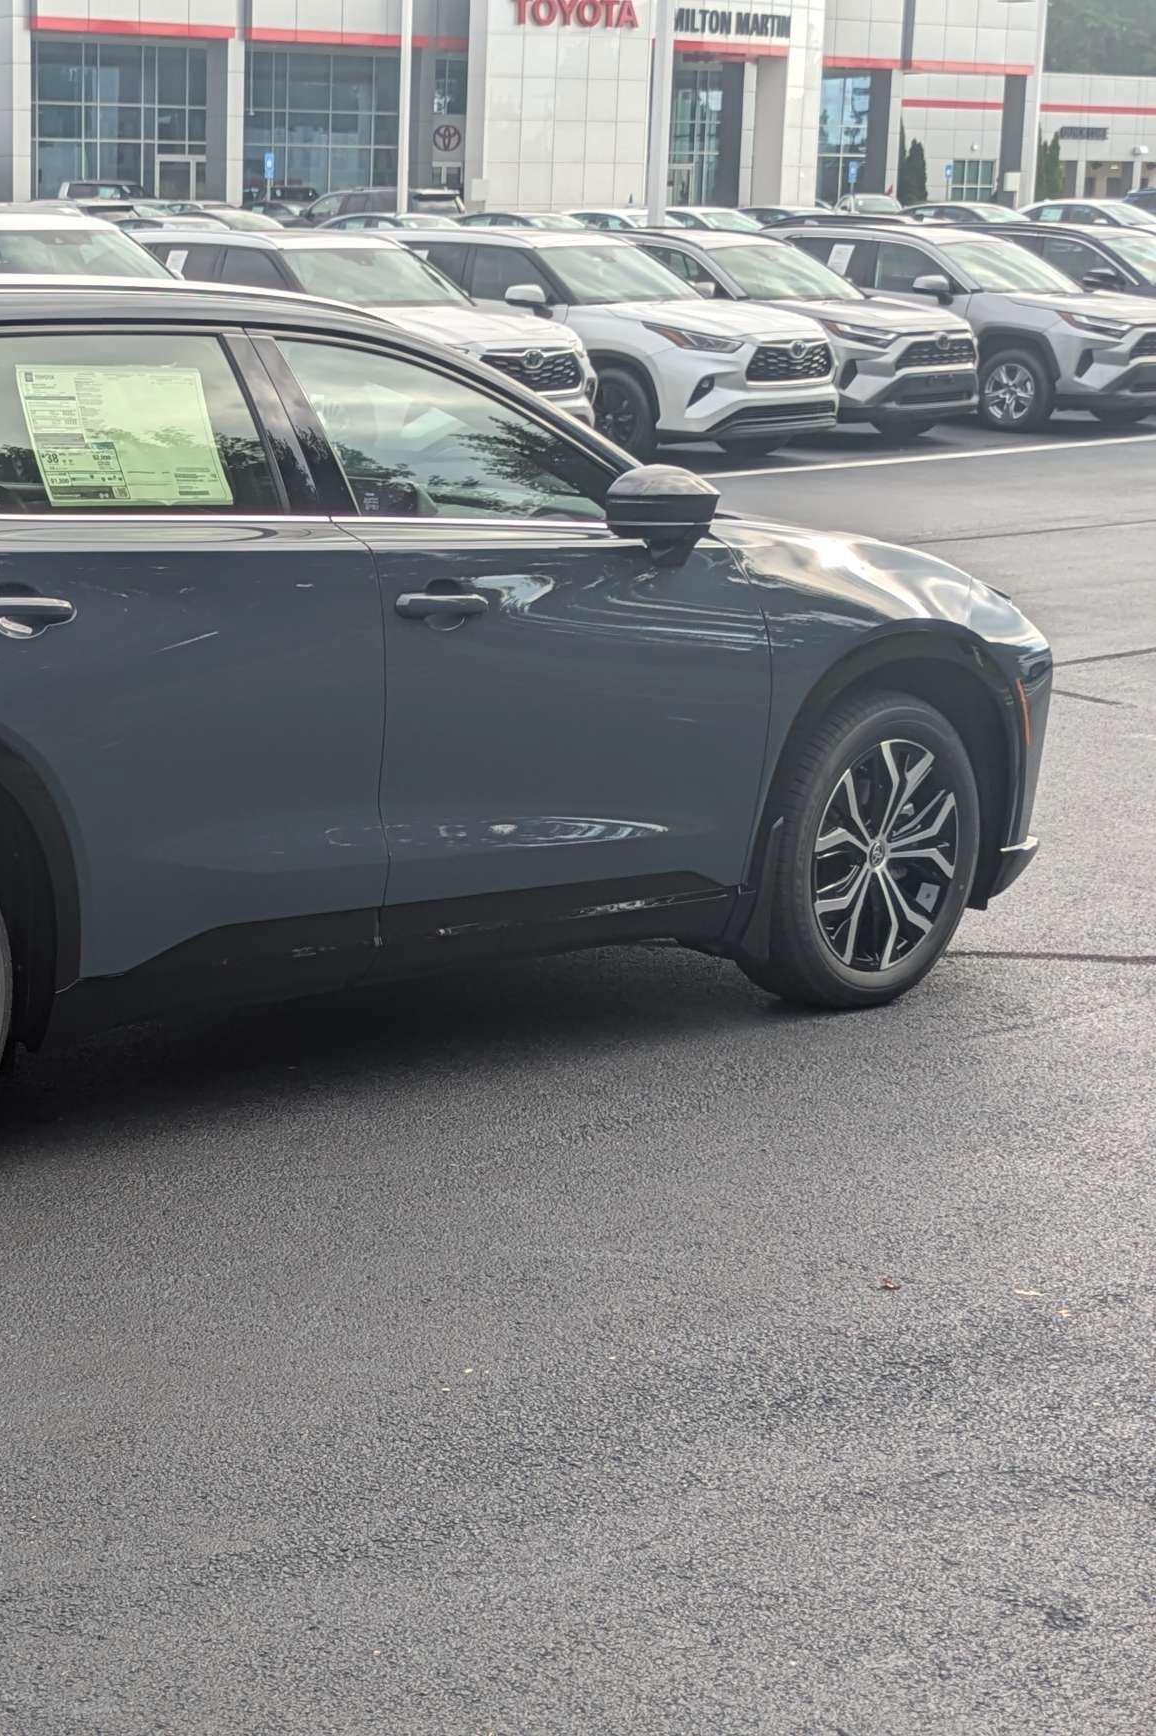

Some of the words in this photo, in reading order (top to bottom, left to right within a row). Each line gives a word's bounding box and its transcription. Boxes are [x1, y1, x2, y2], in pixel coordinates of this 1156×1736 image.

[511, 0, 639, 27] TOYOTA
[734, 12, 791, 38] MARTIN
[45, 453, 60, 464] 38
